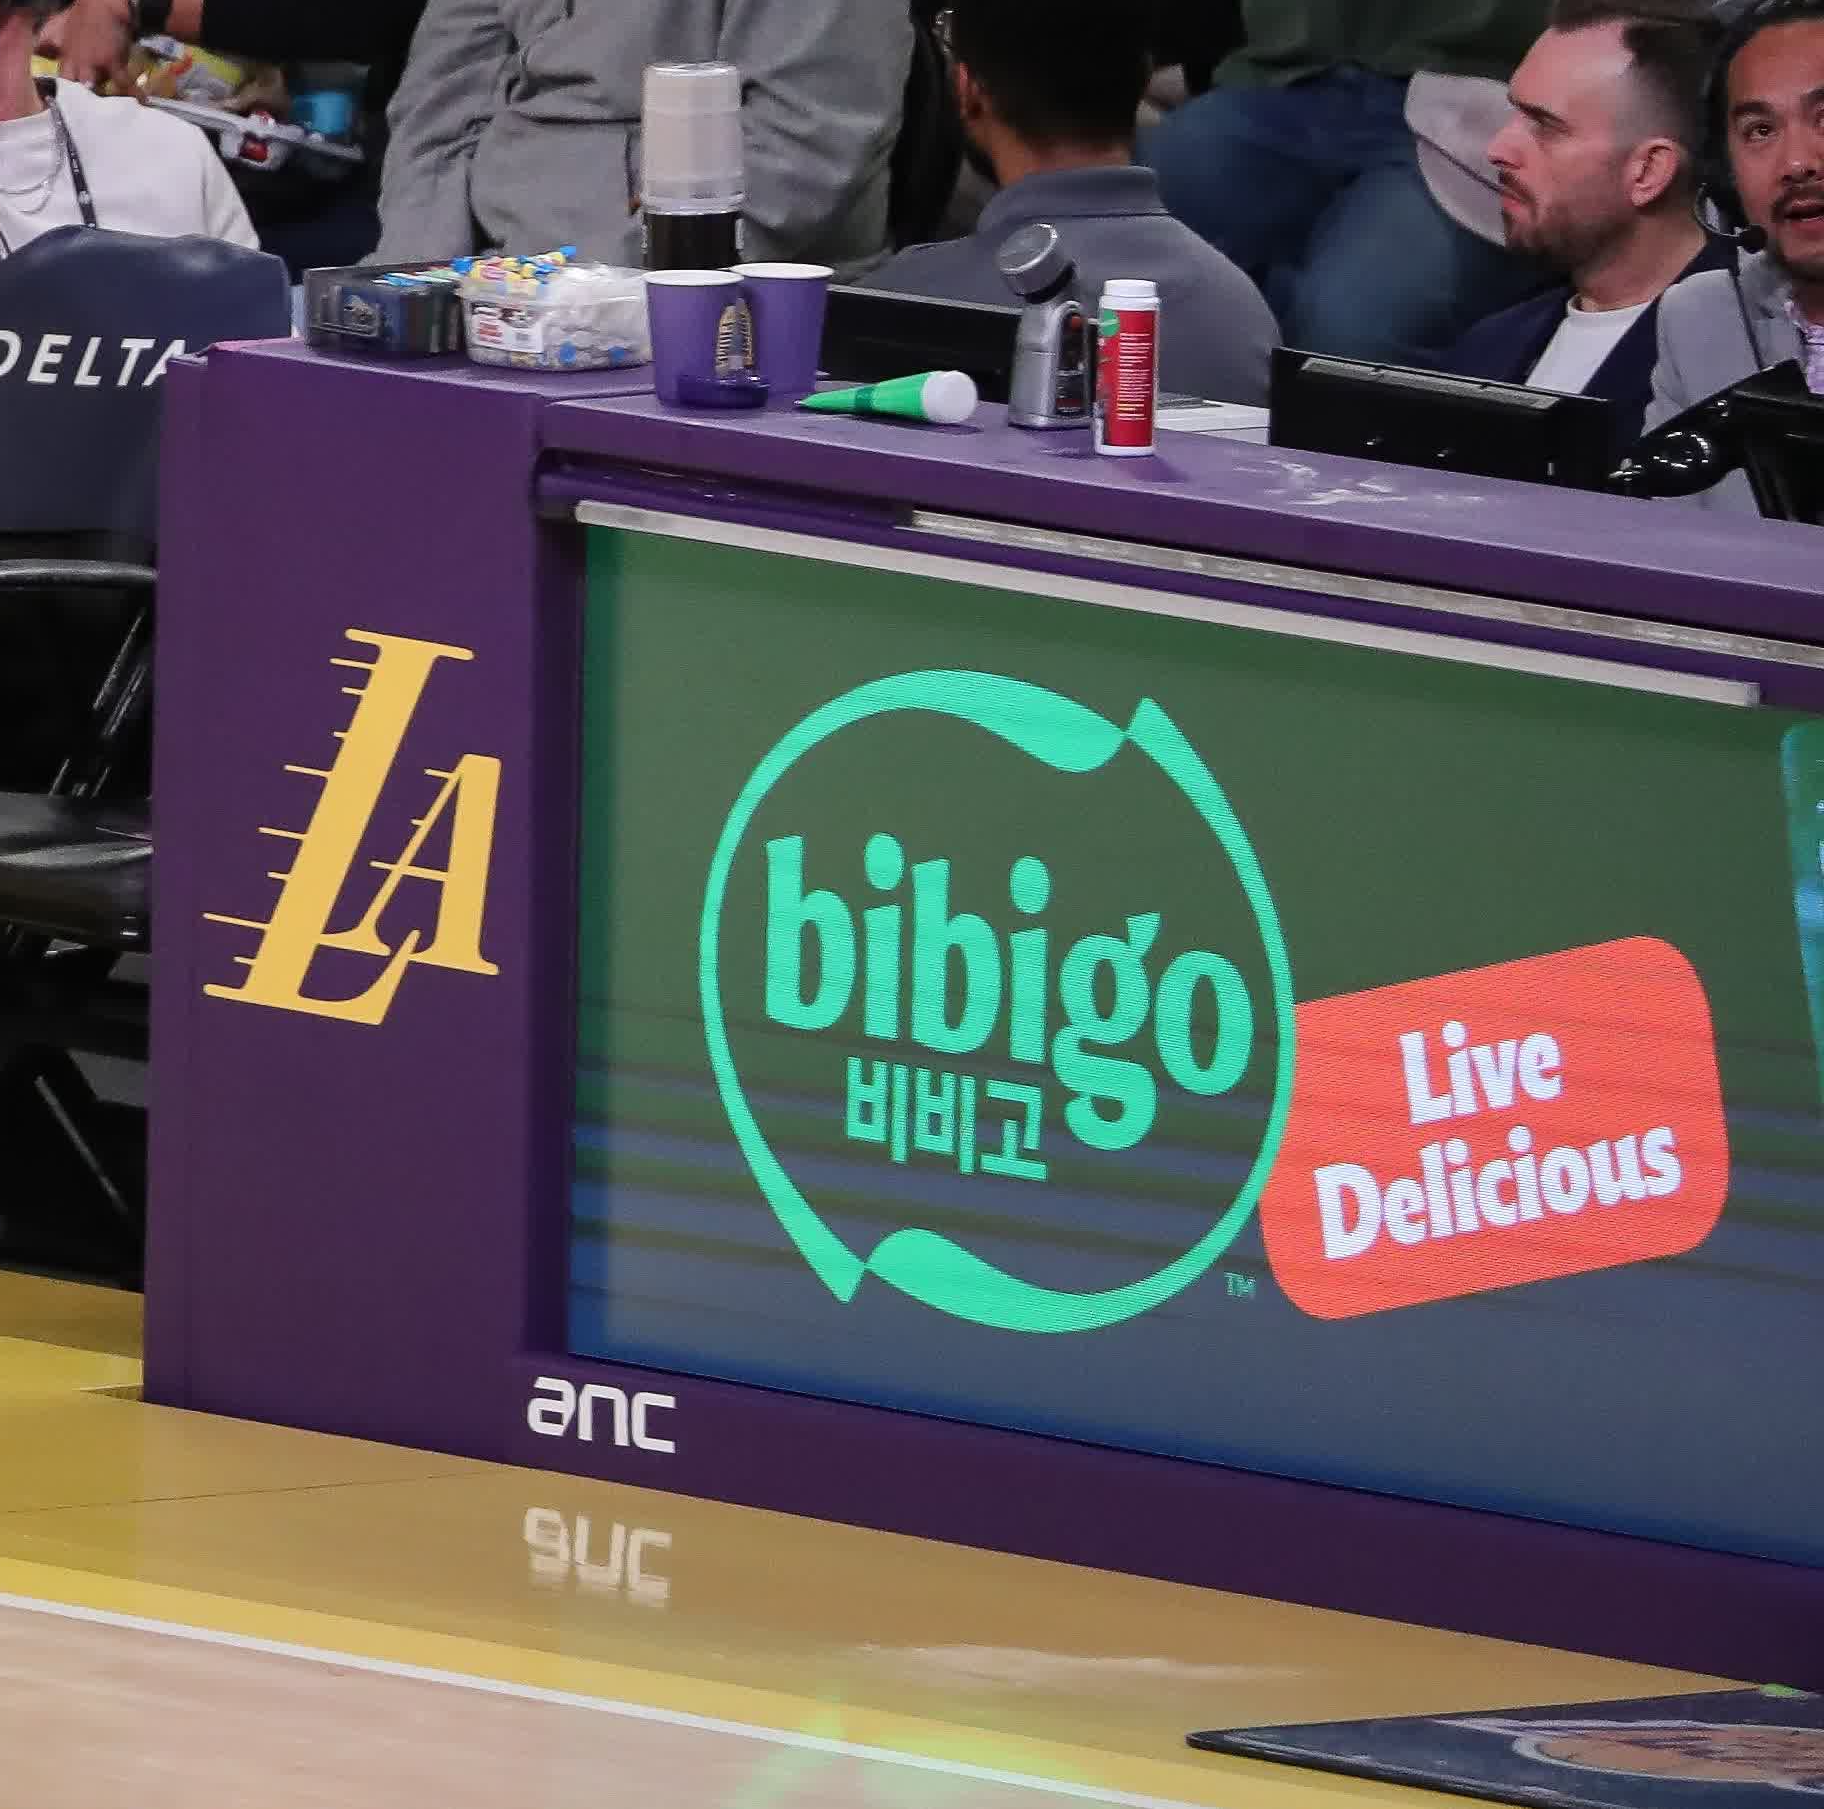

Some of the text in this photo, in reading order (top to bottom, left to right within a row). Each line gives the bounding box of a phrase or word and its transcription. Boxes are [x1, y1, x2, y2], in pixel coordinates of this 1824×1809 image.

[202, 627, 501, 1026] LA
[765, 832, 1253, 1151] bibigo
[845, 1054, 1049, 1183] 비비고
[1399, 1019, 1563, 1127] Live
[1312, 1124, 1684, 1262] Delicious
[526, 1375, 677, 1455] anc
